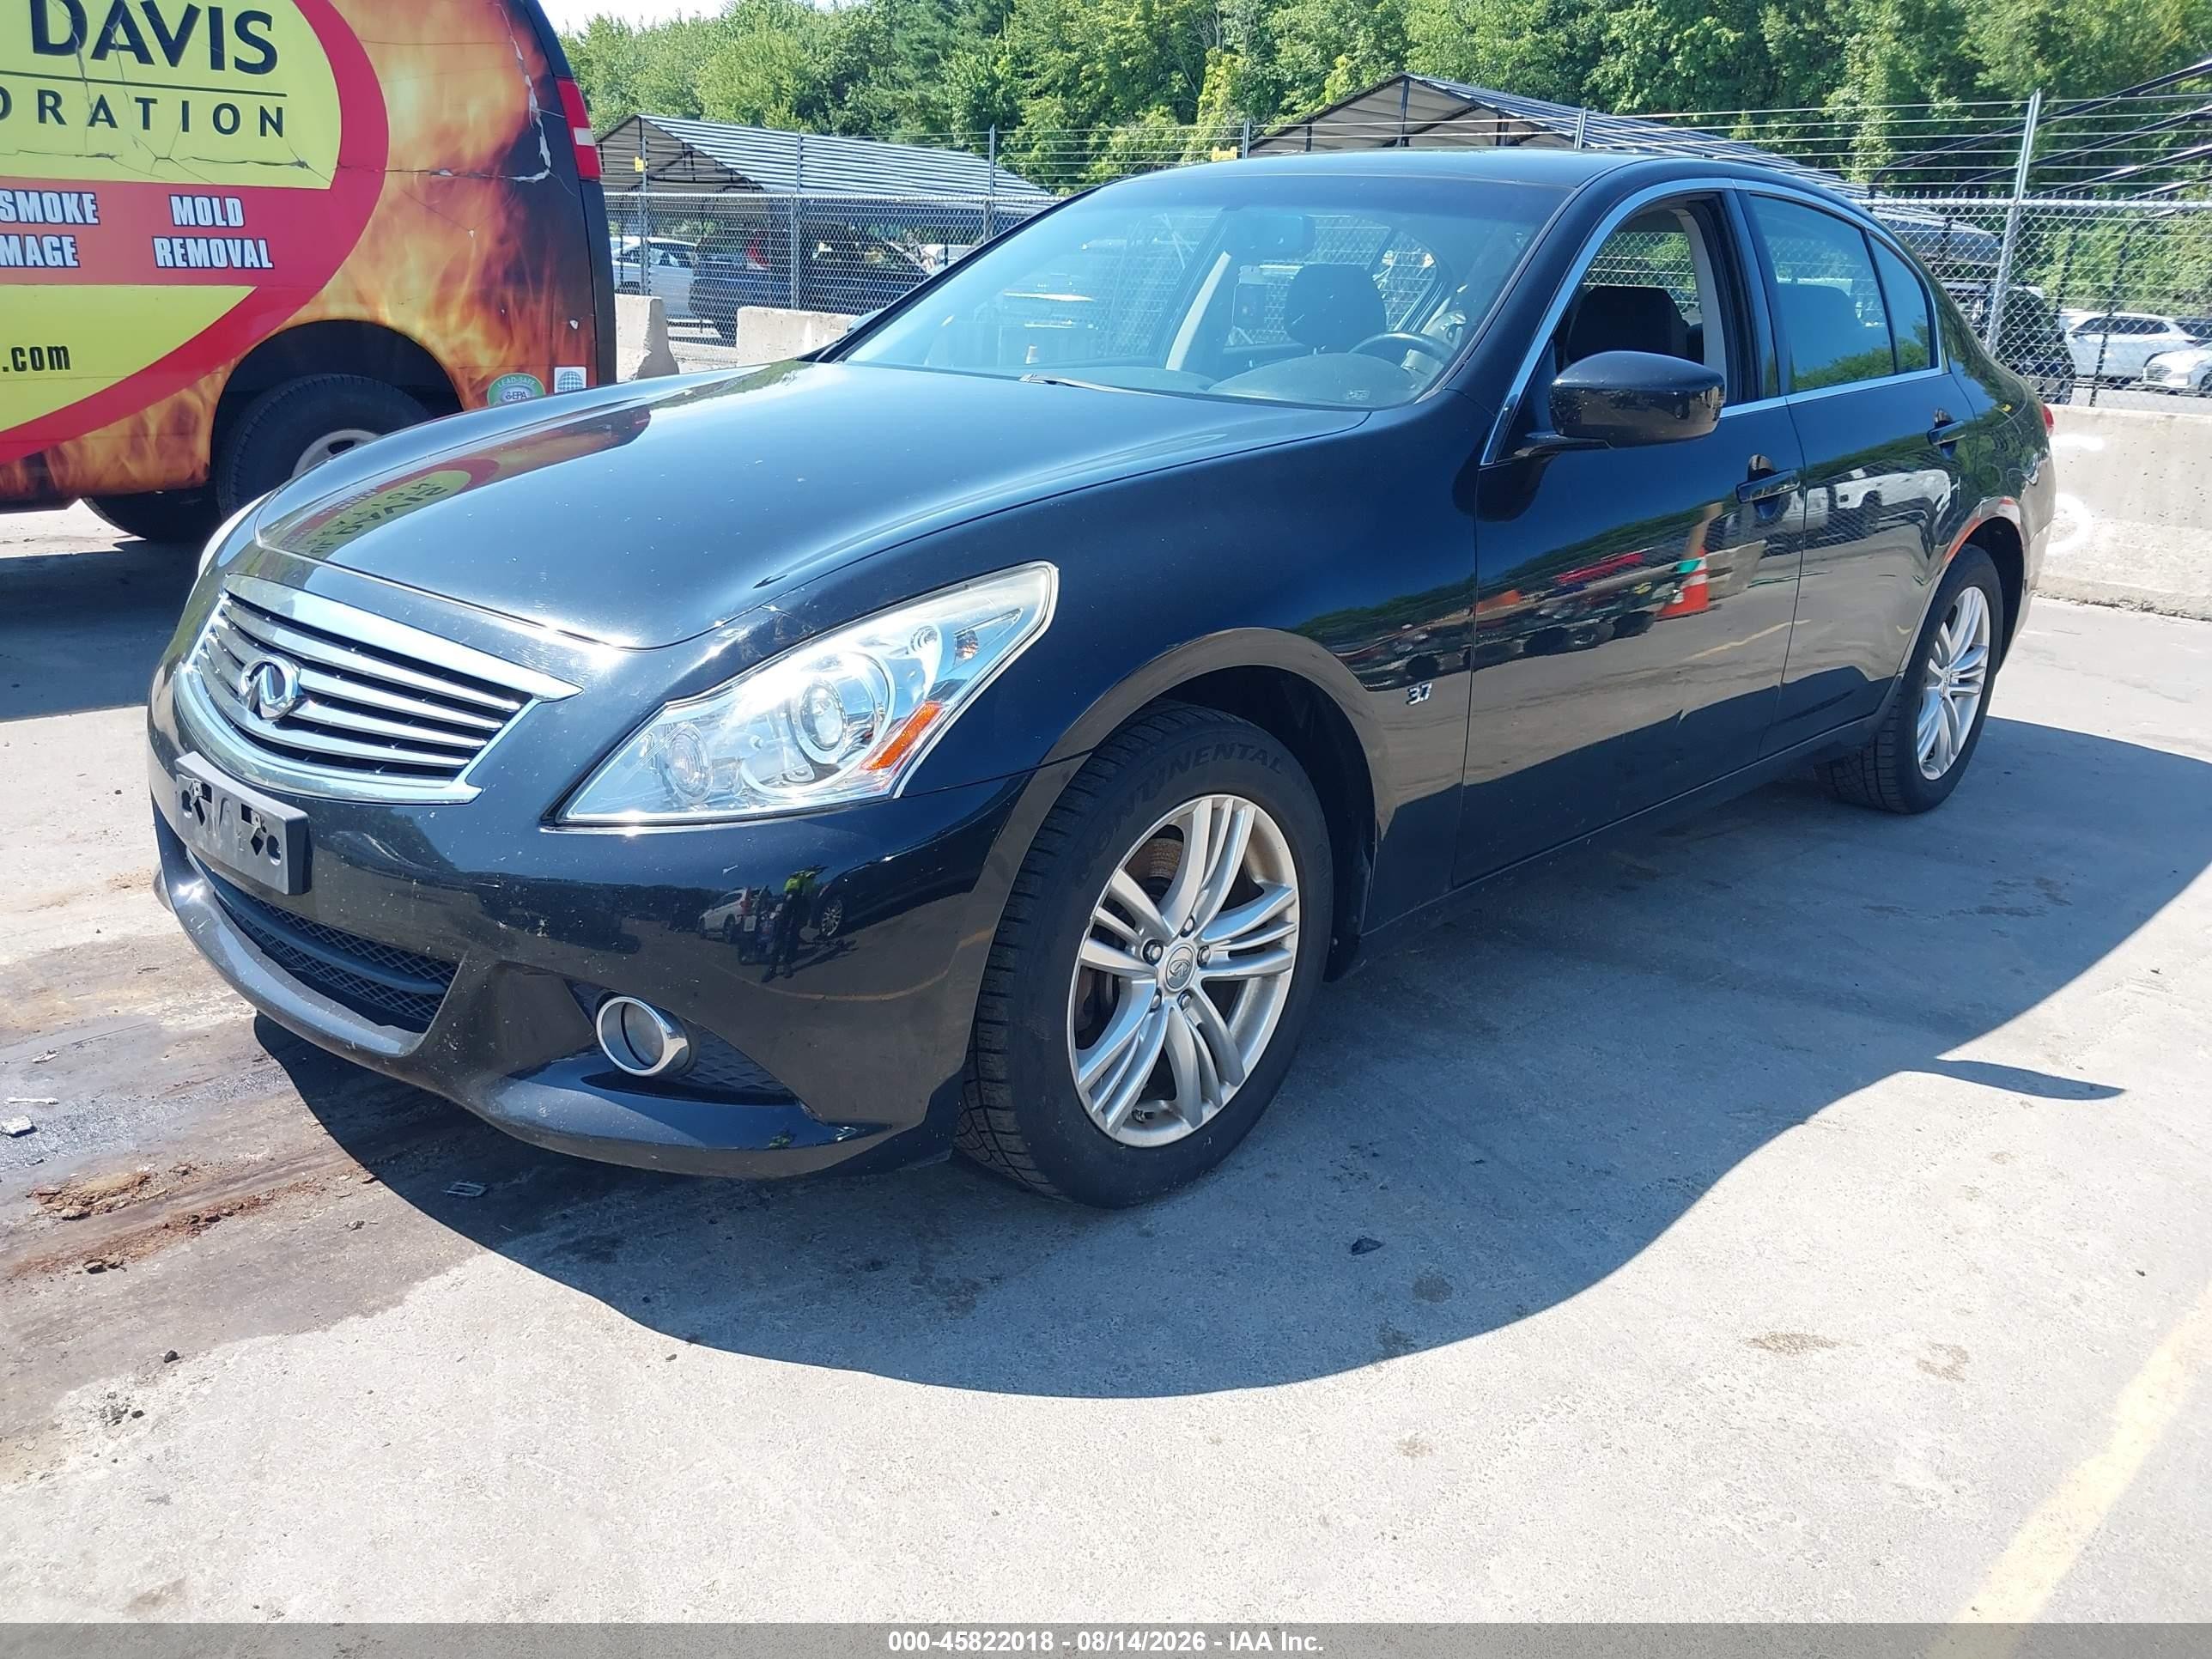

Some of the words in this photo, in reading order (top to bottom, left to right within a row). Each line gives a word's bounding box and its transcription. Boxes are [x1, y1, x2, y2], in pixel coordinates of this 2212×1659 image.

[30, 0, 278, 75] DAVIS
[0, 189, 100, 225] SMOKE
[169, 194, 246, 228] MOLD
[0, 234, 81, 268] MAGE
[152, 236, 275, 269] REMOVAL
[3, 345, 70, 373] .com
